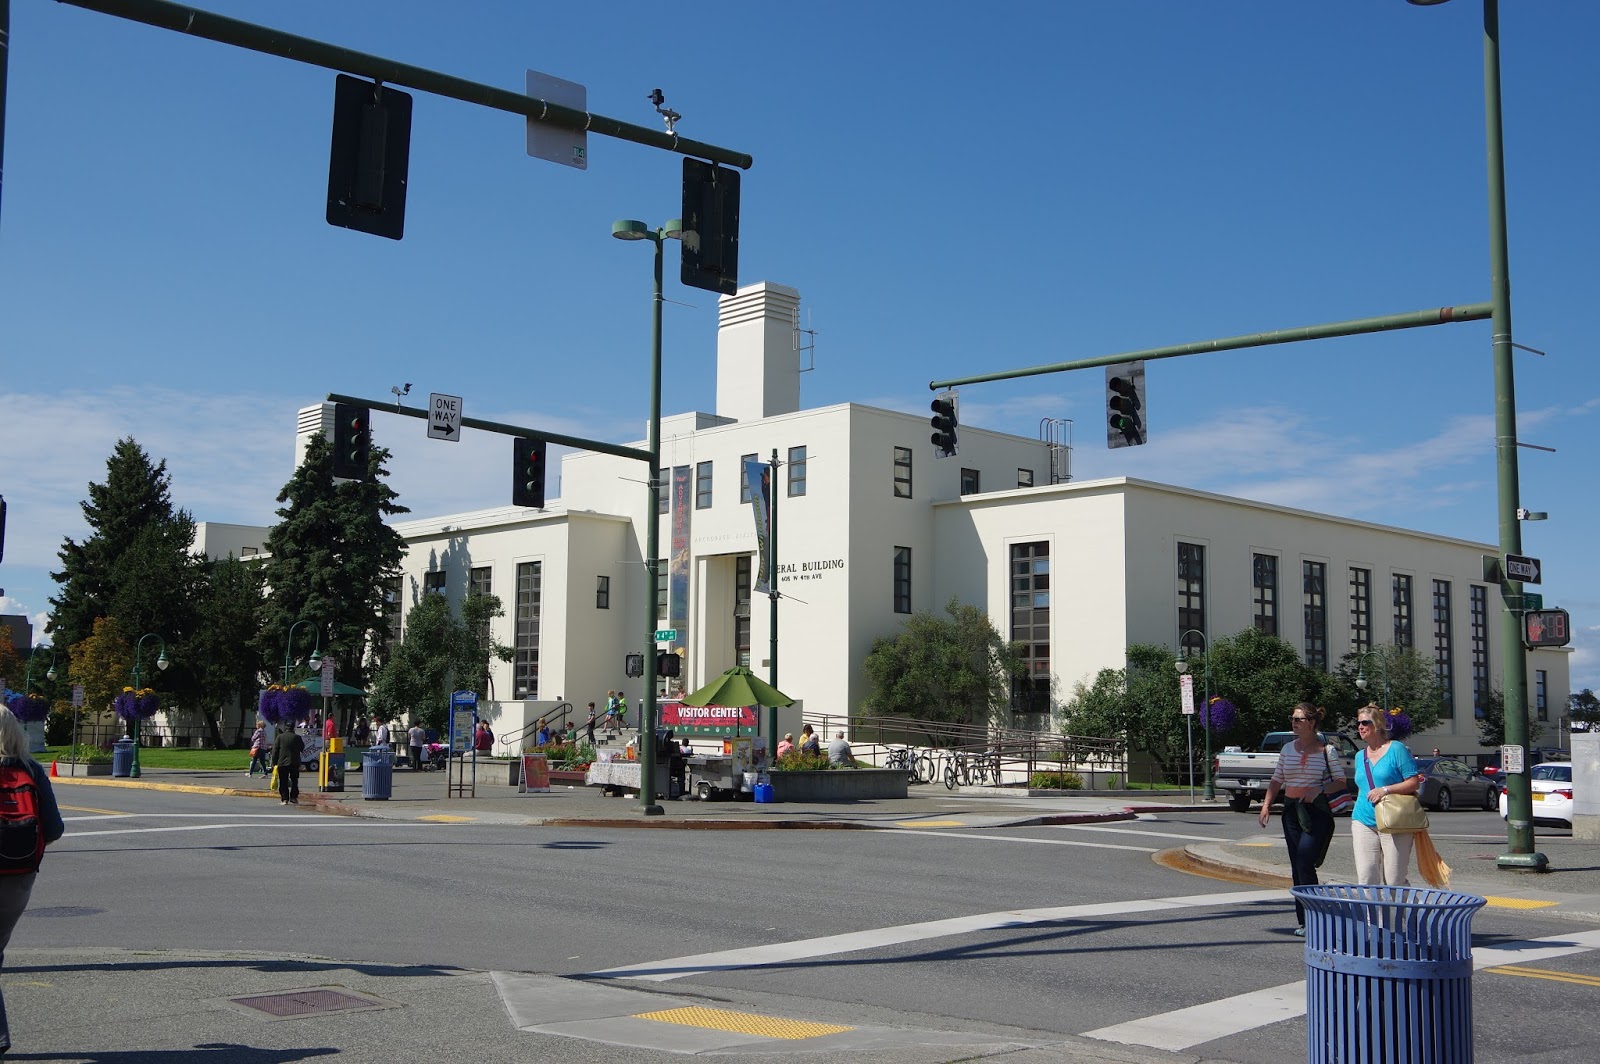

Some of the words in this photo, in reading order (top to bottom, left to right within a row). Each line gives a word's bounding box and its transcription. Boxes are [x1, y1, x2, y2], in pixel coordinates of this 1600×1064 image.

[436, 399, 456, 411] ONE
[435, 411, 456, 422] WAY
[777, 563, 797, 574] ERAL
[802, 559, 845, 572] BUILDING
[1509, 562, 1520, 573] ONE
[1521, 563, 1532, 575] WAY
[677, 707, 709, 718] VISITOR
[710, 707, 743, 718] CENTER
